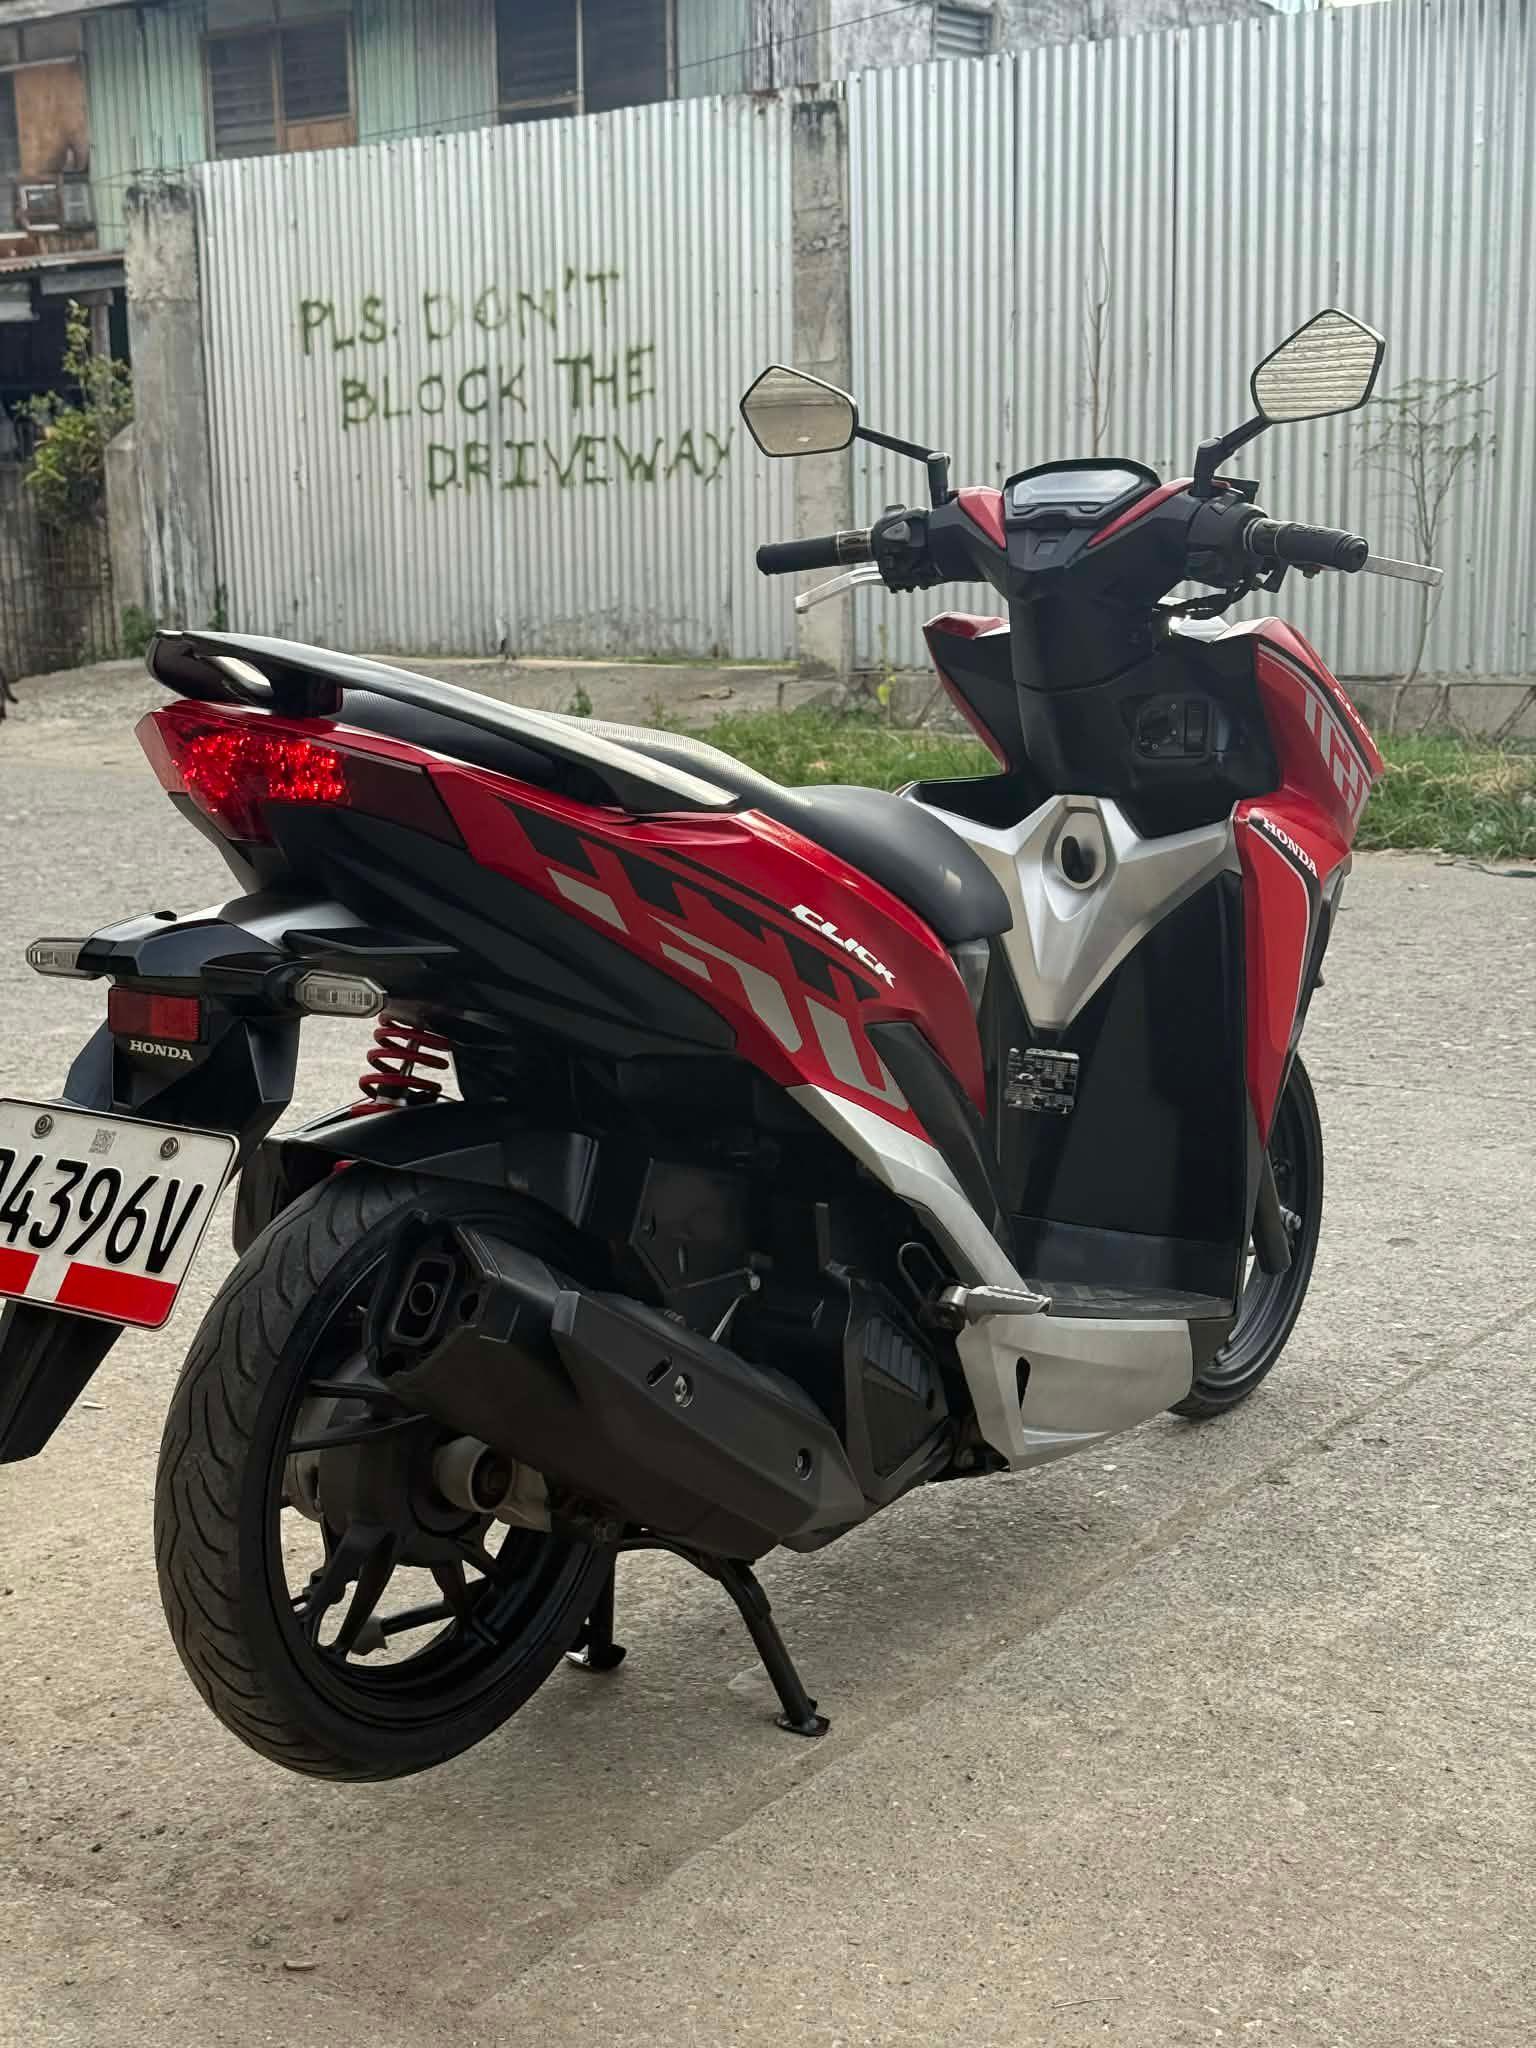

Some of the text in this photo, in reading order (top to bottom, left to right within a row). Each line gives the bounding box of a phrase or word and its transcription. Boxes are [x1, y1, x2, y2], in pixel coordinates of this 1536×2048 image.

[300, 267, 620, 355] PLS. DON'T
[341, 343, 656, 431] BLOCK THE
[427, 426, 736, 499] DRIVEWAY
[1262, 816, 1319, 879] HONDA
[790, 903, 897, 990] CLICK
[129, 1039, 193, 1061] HONDA
